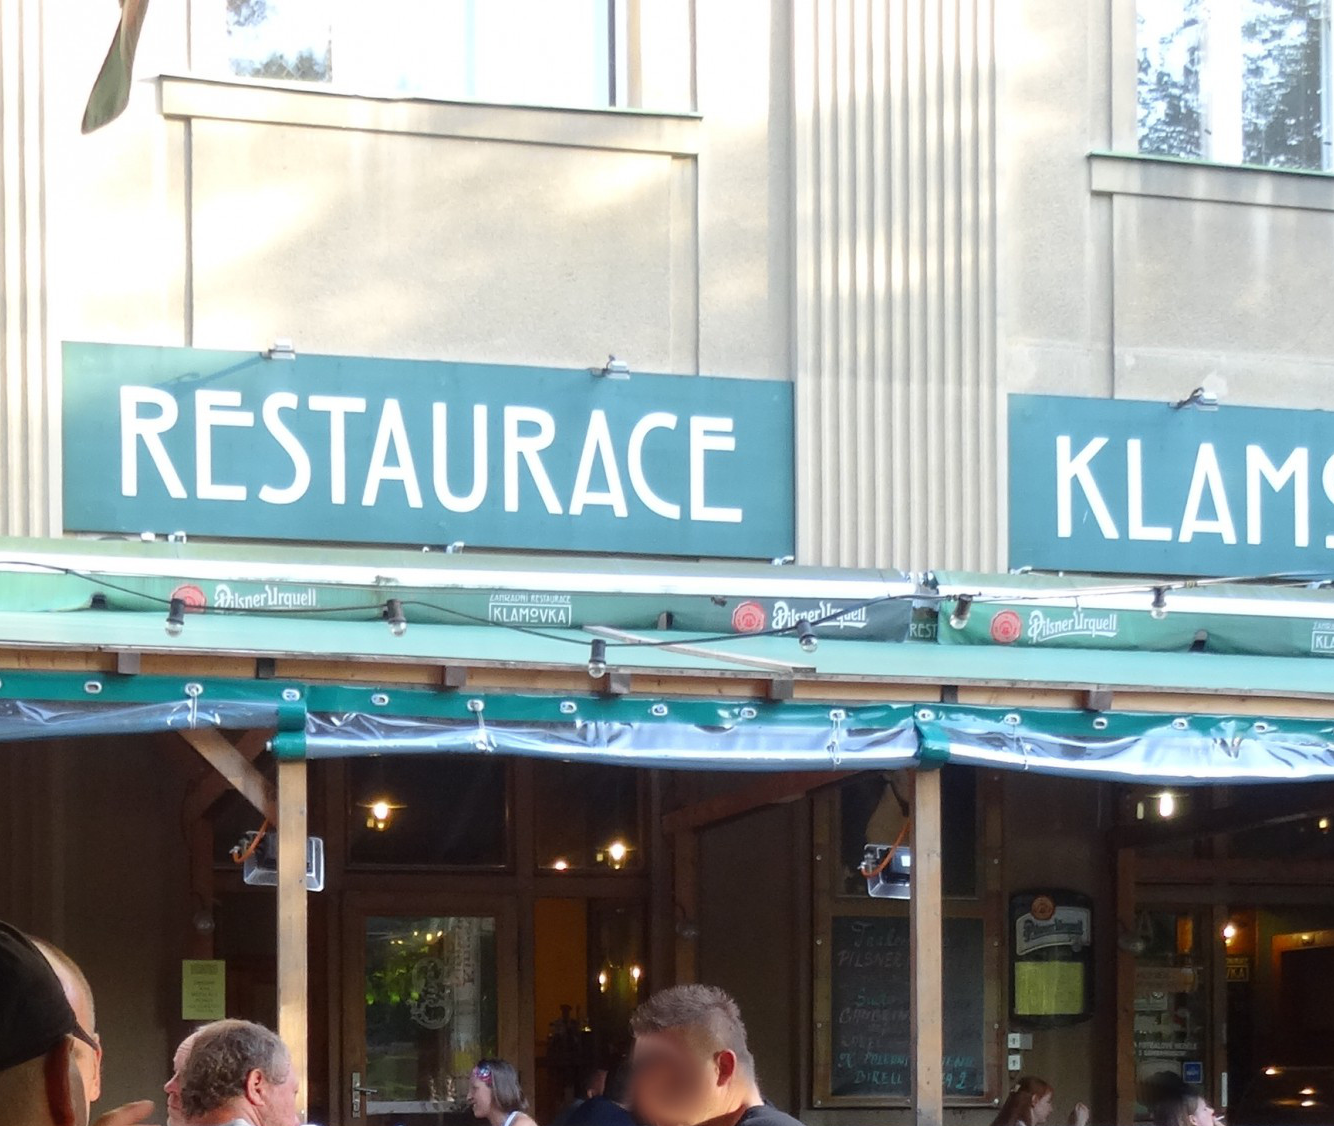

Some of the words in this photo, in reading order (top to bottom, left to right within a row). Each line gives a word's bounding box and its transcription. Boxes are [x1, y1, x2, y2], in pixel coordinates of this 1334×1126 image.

[120, 386, 743, 523] RESTAURACE
[214, 584, 266, 613] Pilsner
[265, 584, 316, 609] Urquell
[493, 607, 567, 623] KLAMOVKA
[1028, 609, 1074, 643] Pilsner
[1073, 607, 1117, 638] Urquell
